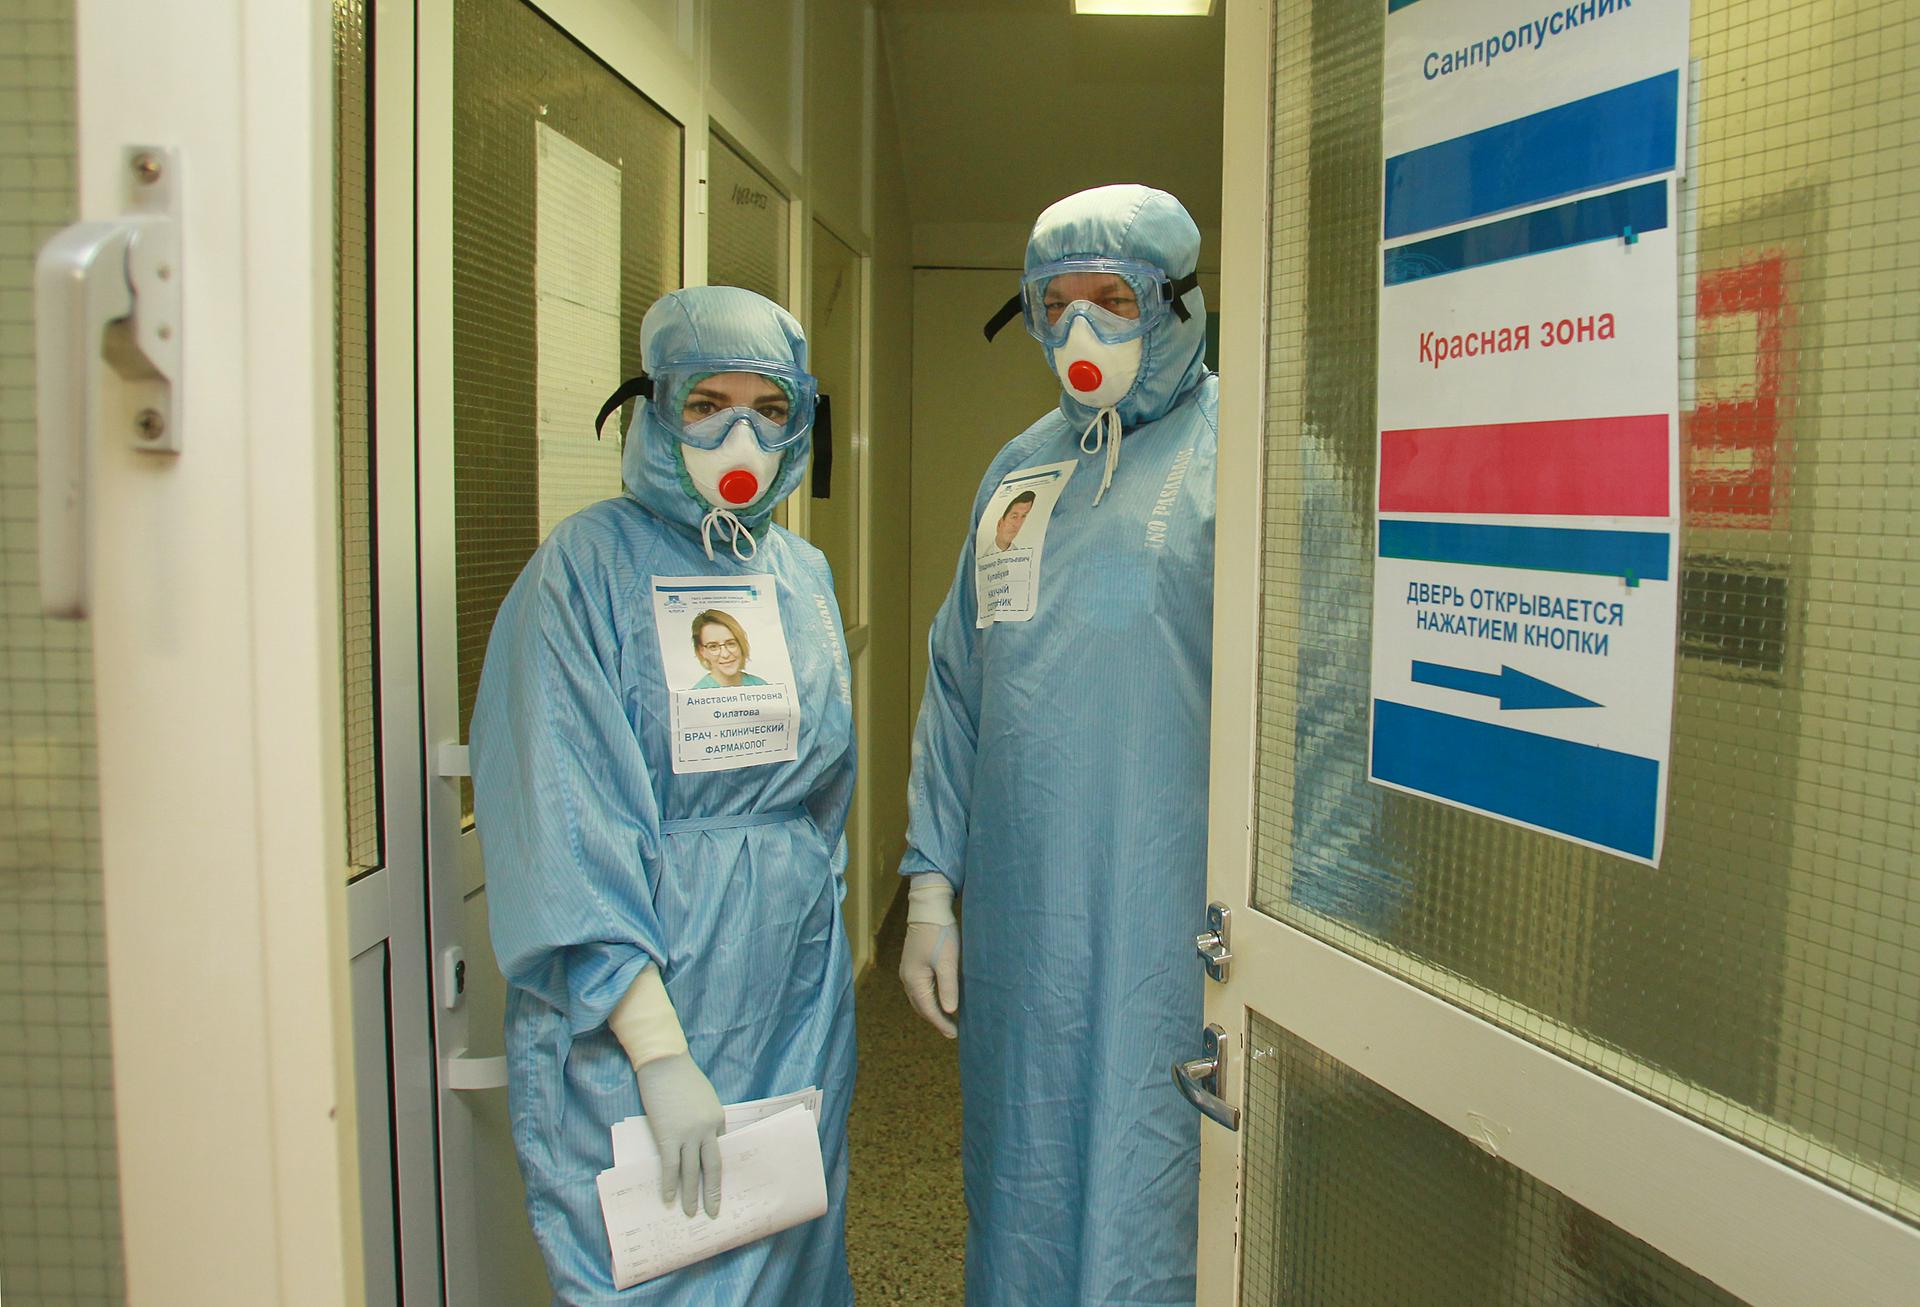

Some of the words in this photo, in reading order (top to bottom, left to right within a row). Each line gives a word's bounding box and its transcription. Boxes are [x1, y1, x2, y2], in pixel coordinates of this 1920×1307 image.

[1419, 324, 1530, 369] Красная
[1540, 312, 1615, 347] зона
[1407, 581, 1464, 606] ДВЕРЬ
[1470, 588, 1623, 627] ОТКРЫВАЕТСЯ
[1417, 609, 1517, 643] НАЖАТИЕМ
[1524, 623, 1609, 656] КНОПКИ
[686, 695, 738, 706] Анастасия
[739, 691, 783, 703] Петровна
[713, 708, 760, 719] Филатова
[684, 731, 712, 742] ВРАЧ
[720, 722, 785, 739] КЛИНИЧЕСКИЙ
[705, 739, 767, 754] ФАРМАКОЛОГ
